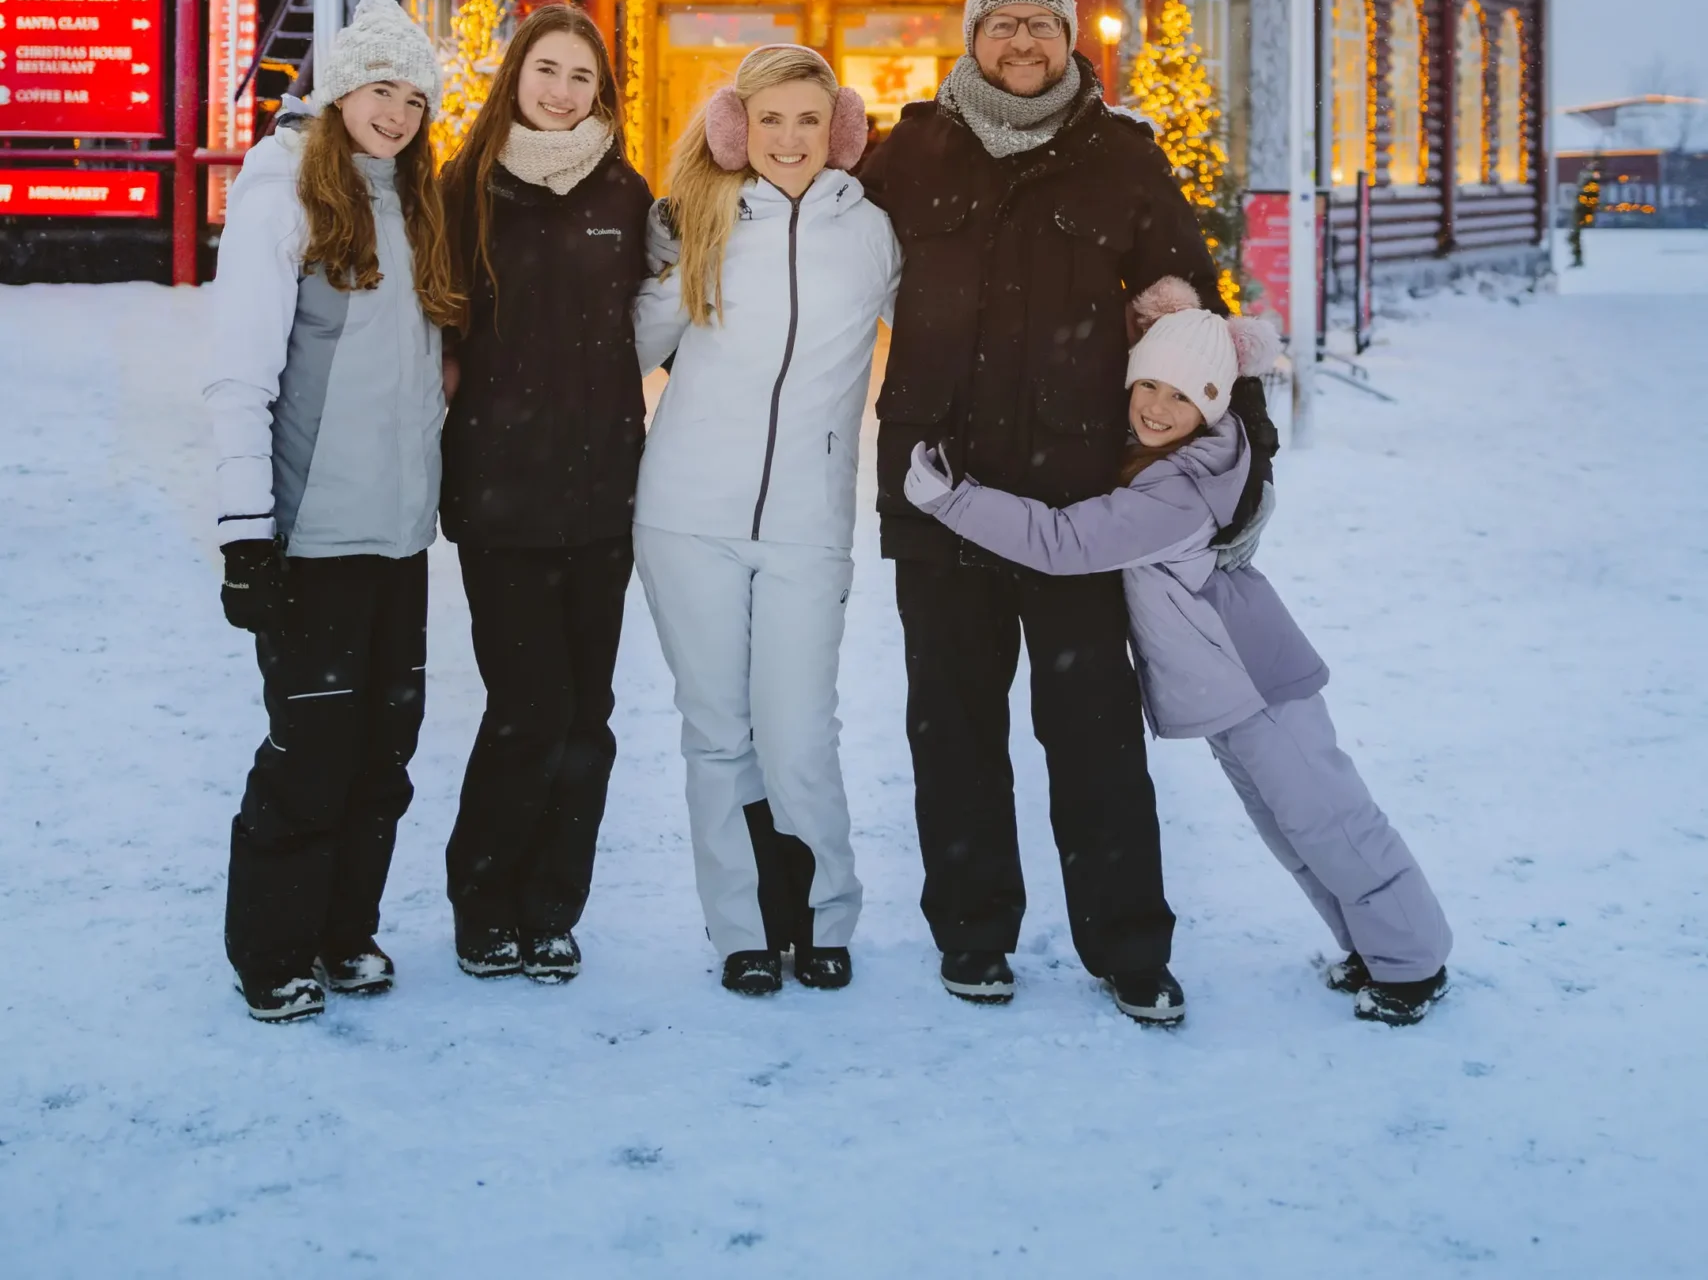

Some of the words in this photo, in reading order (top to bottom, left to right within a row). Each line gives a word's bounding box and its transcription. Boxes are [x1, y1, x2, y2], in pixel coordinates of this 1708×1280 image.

[16, 16, 57, 30] SANTA
[57, 16, 100, 31] CLAUS
[15, 45, 88, 60] CHRISTMAS
[88, 46, 133, 61] HOUSE
[16, 60, 96, 74] RESTAURANT
[15, 89, 62, 104] COFFEE
[63, 89, 90, 104] BAR
[28, 185, 109, 201] MINIMARKET
